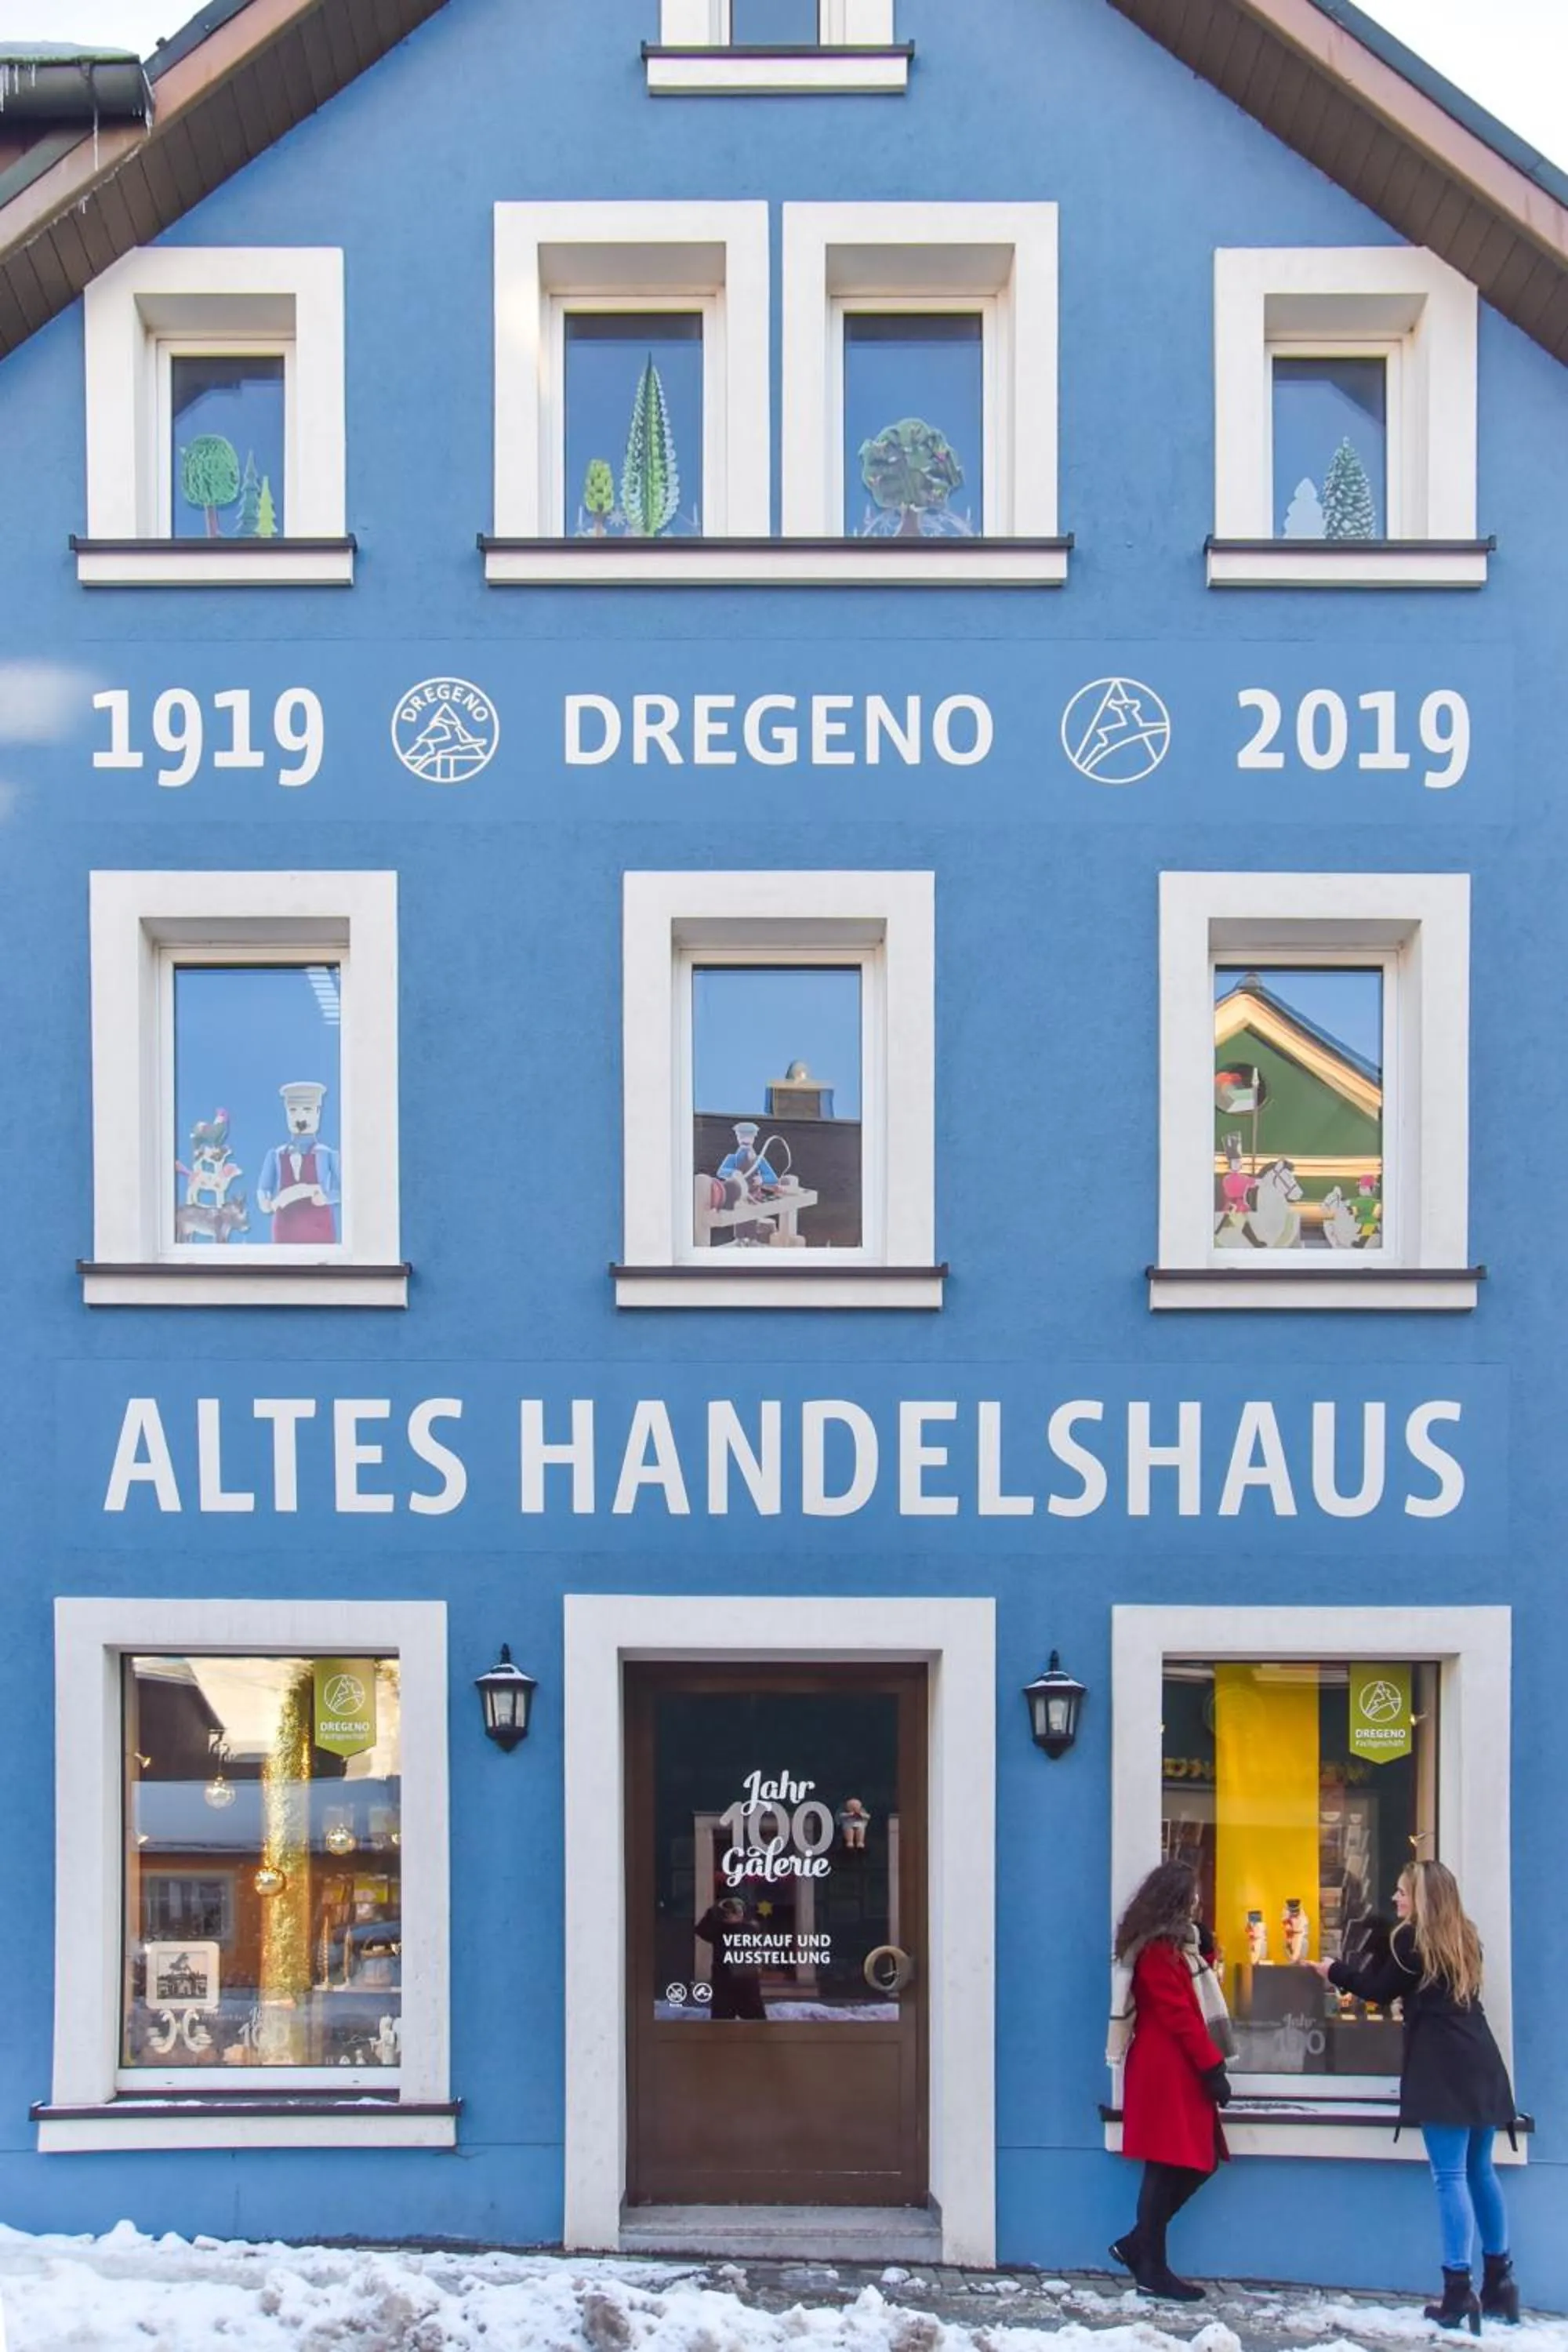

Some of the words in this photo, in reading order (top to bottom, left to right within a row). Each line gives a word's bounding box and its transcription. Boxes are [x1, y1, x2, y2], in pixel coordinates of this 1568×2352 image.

[401, 684, 488, 722] DREGENO
[91, 687, 325, 787] 1919
[564, 694, 993, 766] DREGENO
[1237, 688, 1470, 789] 2019
[103, 1398, 467, 1515] ALTES
[521, 1399, 1465, 1518] HANDELSHAUS
[320, 1722, 370, 1732] DREGENO
[1356, 1729, 1406, 1738] DREGENO
[742, 1769, 815, 1816] Jahr
[719, 1801, 834, 1856] 100
[721, 1835, 832, 1887] Galerie
[722, 1933, 793, 1947] VERKAUF
[797, 1933, 832, 1947] UND
[723, 1951, 831, 1965] AUSSTELLUNG
